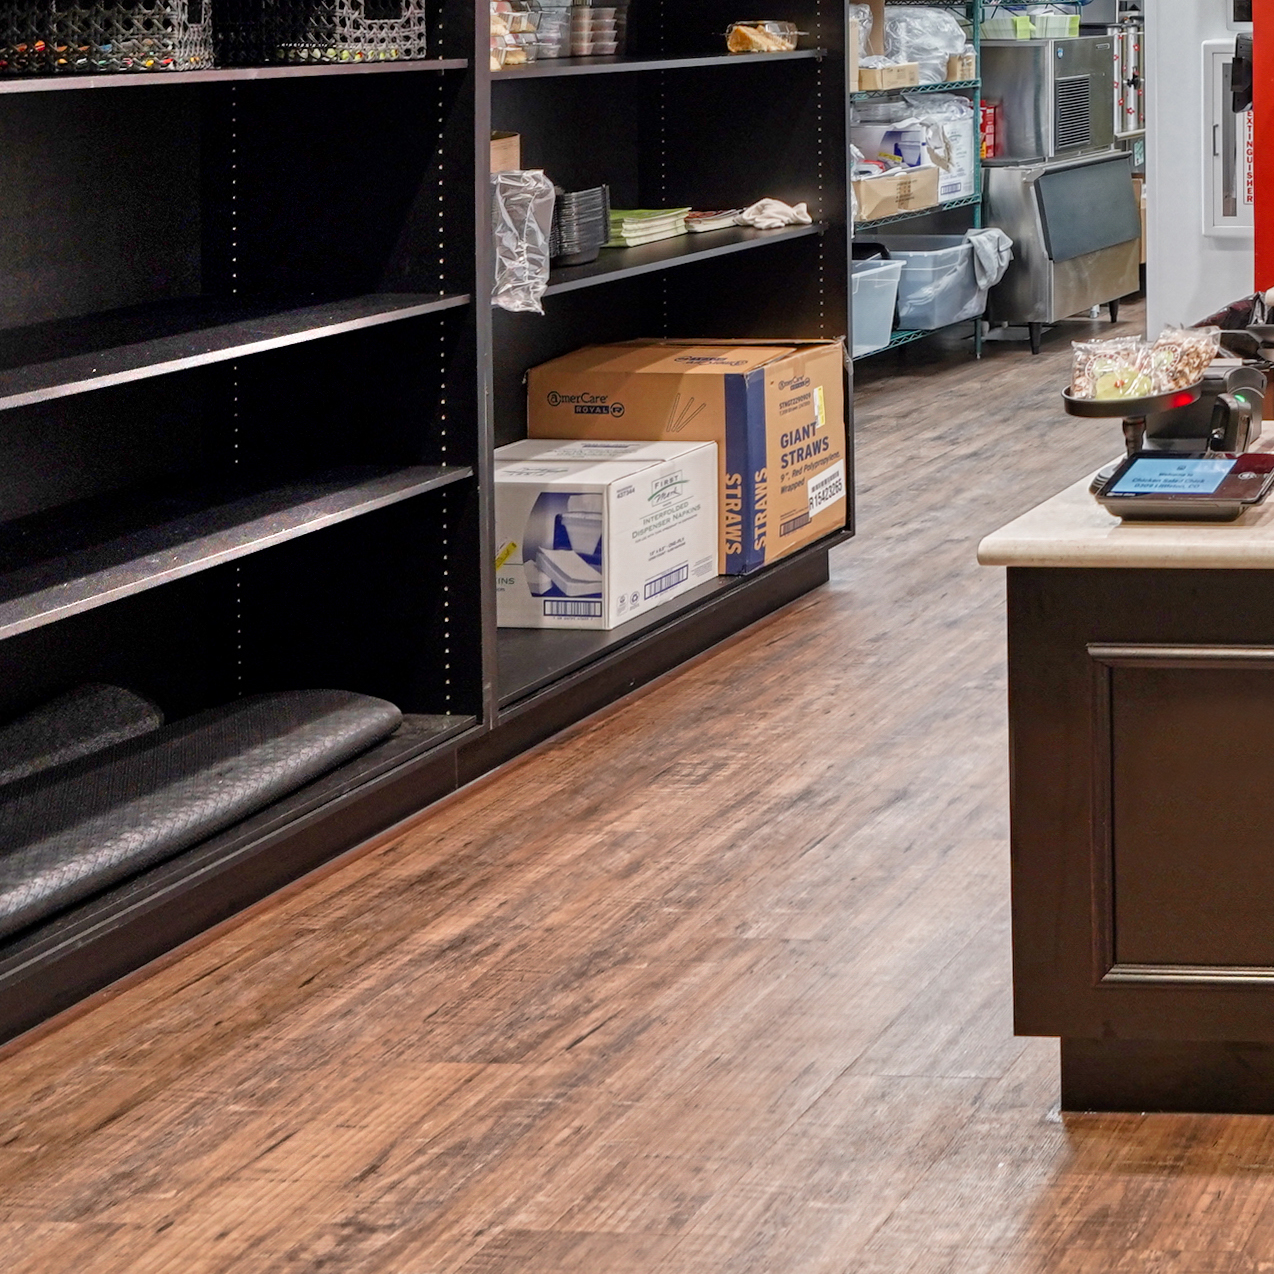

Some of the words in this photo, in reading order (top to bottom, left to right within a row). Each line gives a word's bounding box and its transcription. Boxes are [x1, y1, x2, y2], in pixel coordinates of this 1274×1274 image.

[575, 406, 609, 414] ROYAL
[780, 421, 817, 449] GIANT
[780, 435, 830, 469] STRAWS
[654, 474, 679, 490] FIRST
[632, 518, 671, 539] DISPENSER
[673, 503, 701, 522] NAPKINS
[642, 501, 689, 525] INTERFOLDED
[725, 473, 742, 555] STRAWS
[754, 467, 767, 551] STRAWS
